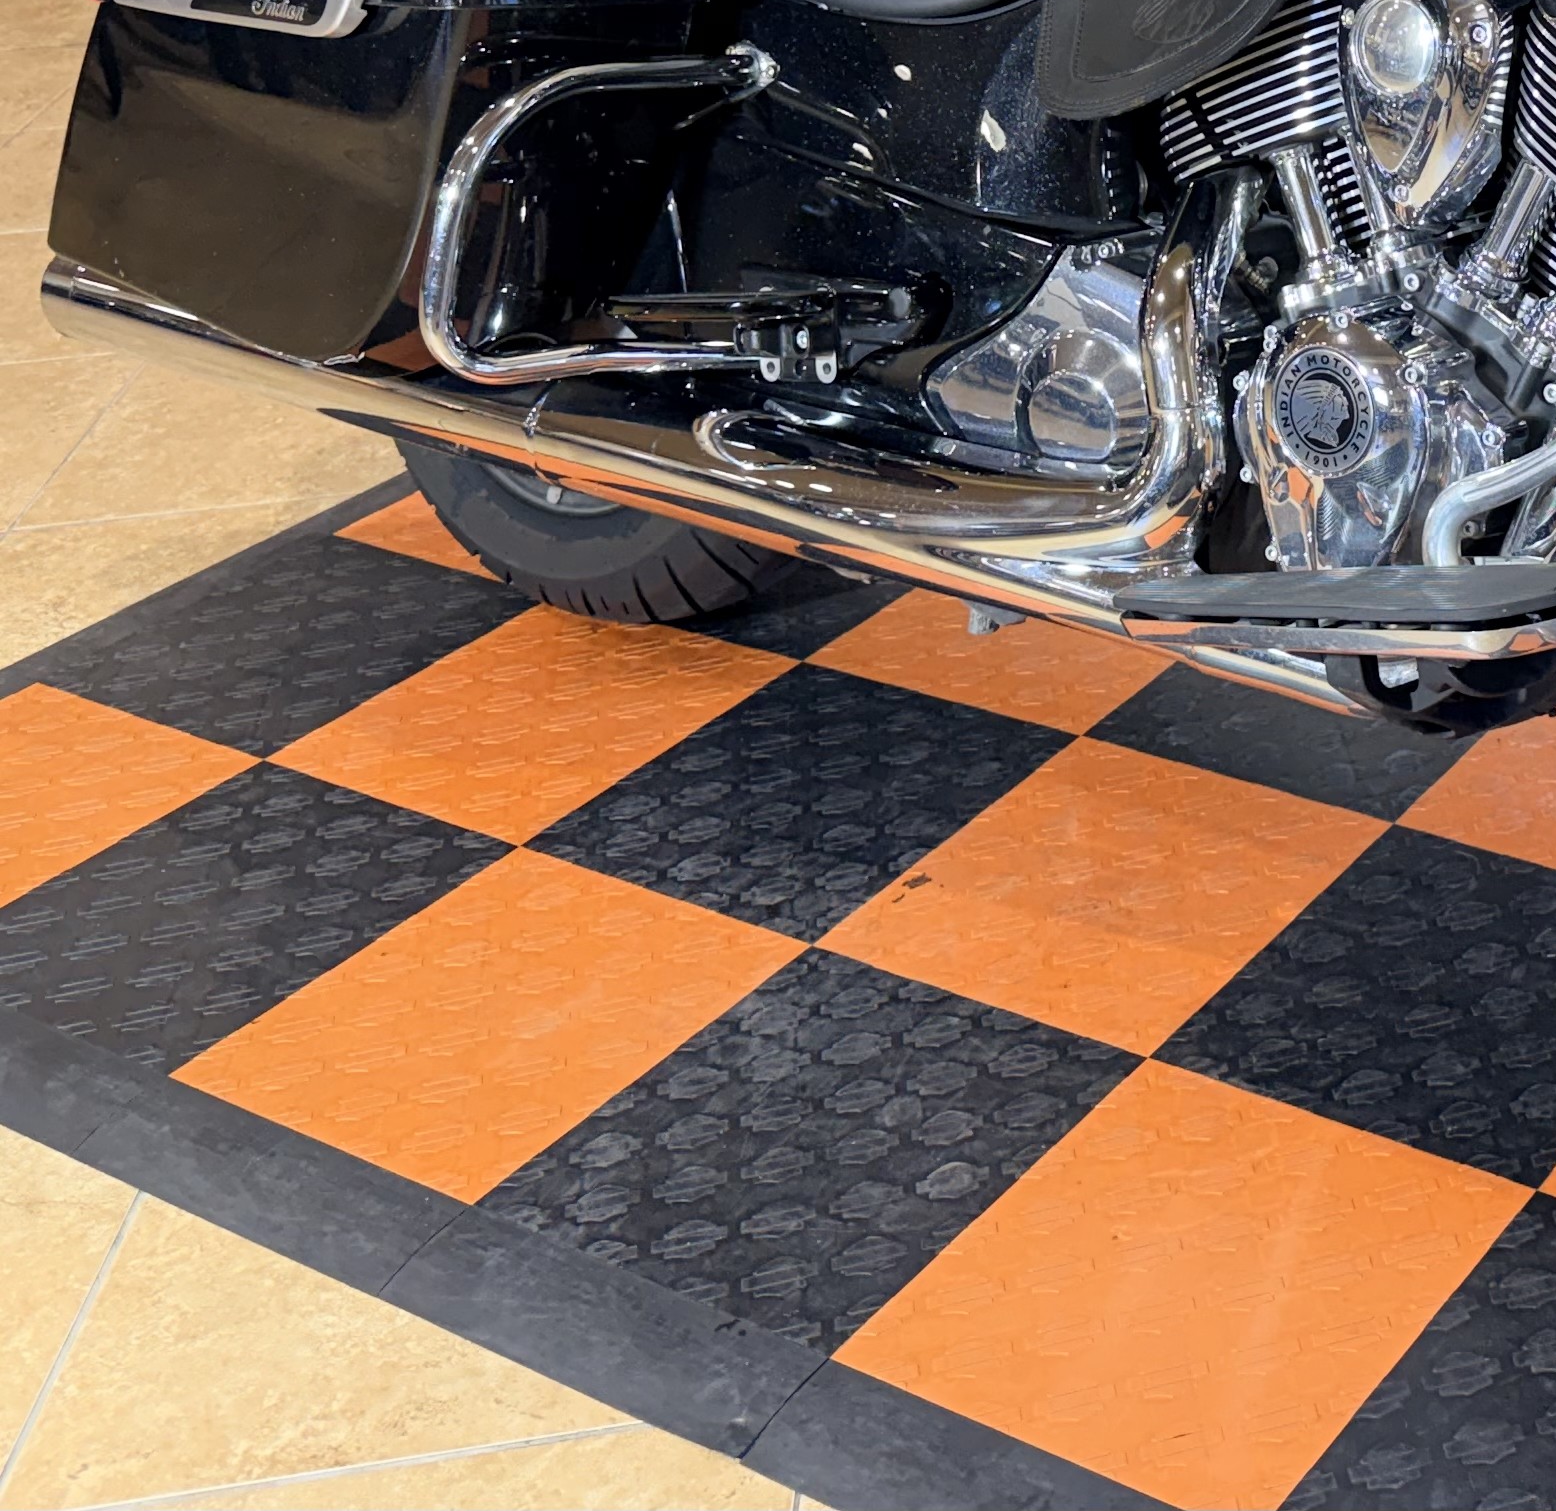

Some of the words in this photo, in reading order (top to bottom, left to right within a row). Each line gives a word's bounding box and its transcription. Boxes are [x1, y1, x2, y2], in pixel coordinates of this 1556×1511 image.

[1280, 365, 1302, 438] INDIAN
[1307, 355, 1369, 453] MOTORCYCLE
[1305, 451, 1338, 467] 1901
